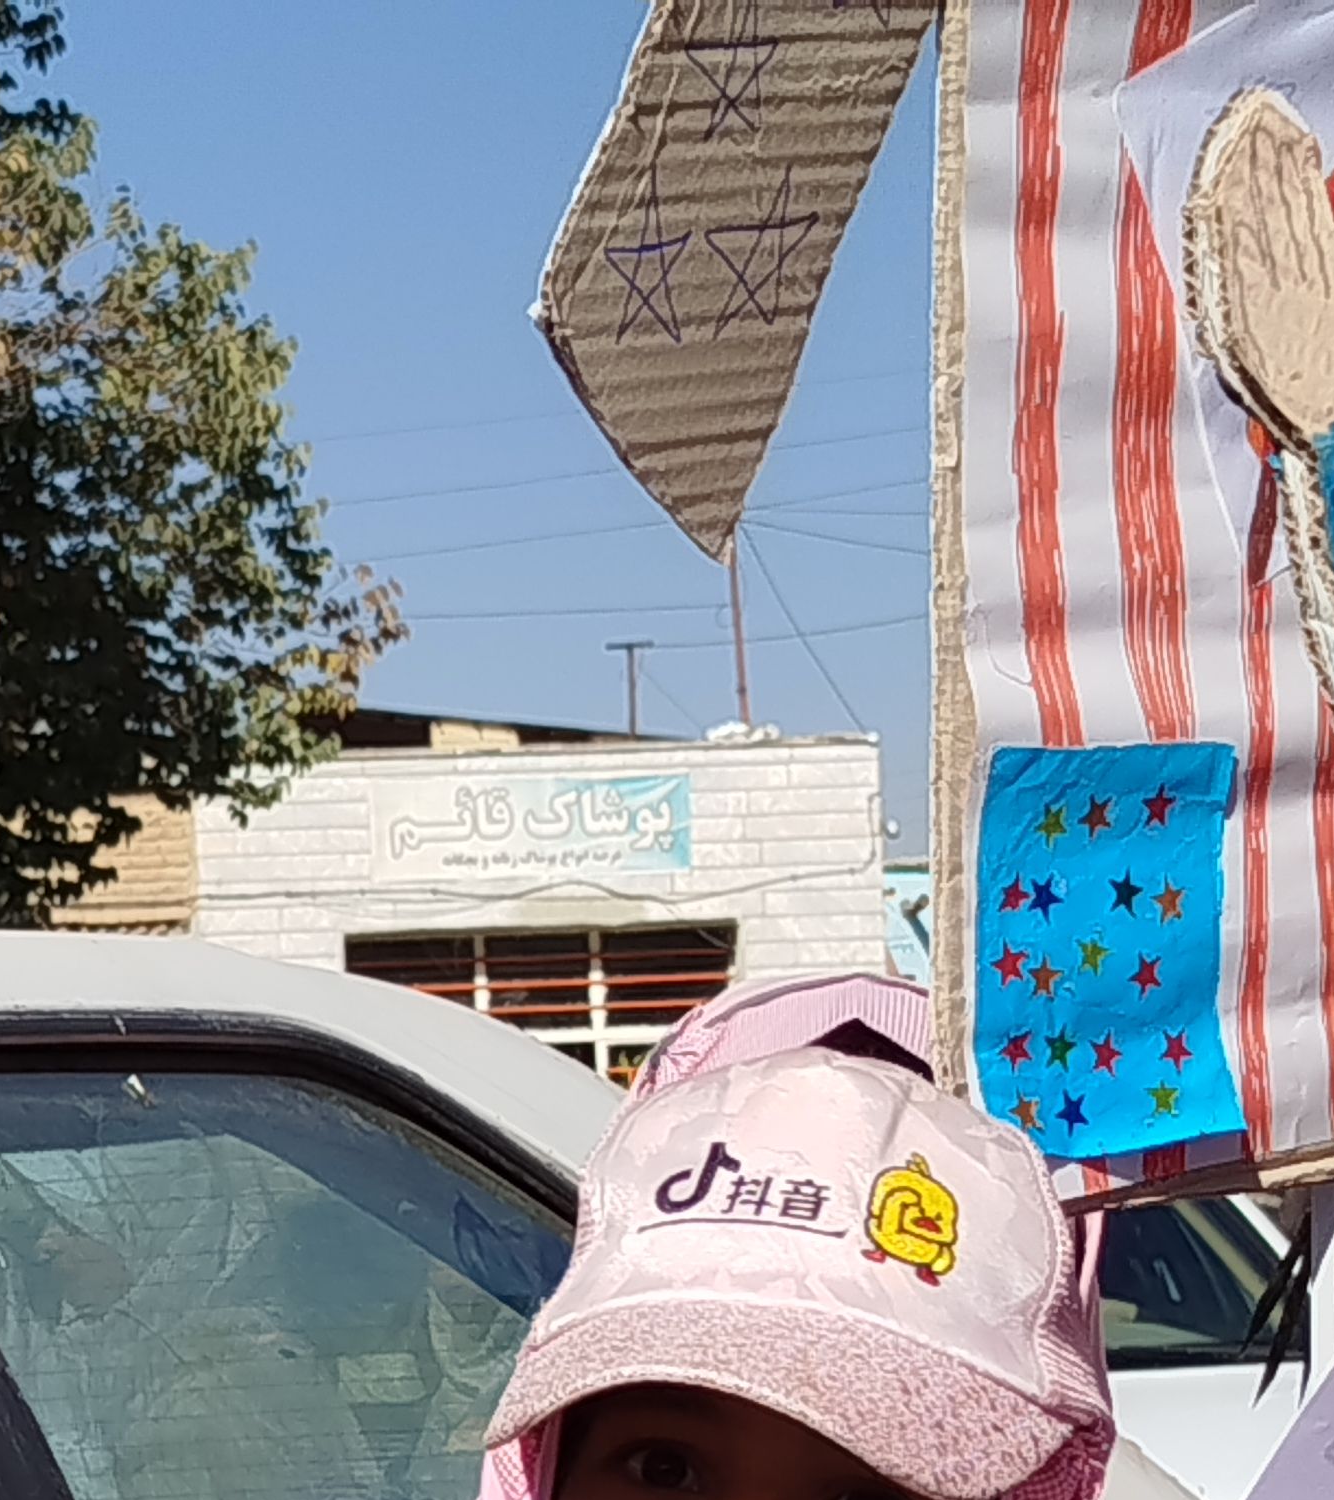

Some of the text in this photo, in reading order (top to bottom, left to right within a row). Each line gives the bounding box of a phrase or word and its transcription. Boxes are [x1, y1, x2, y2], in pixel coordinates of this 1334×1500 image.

[389, 786, 675, 860] پوشاک قائم
[720, 1175, 831, 1221] 抖音
